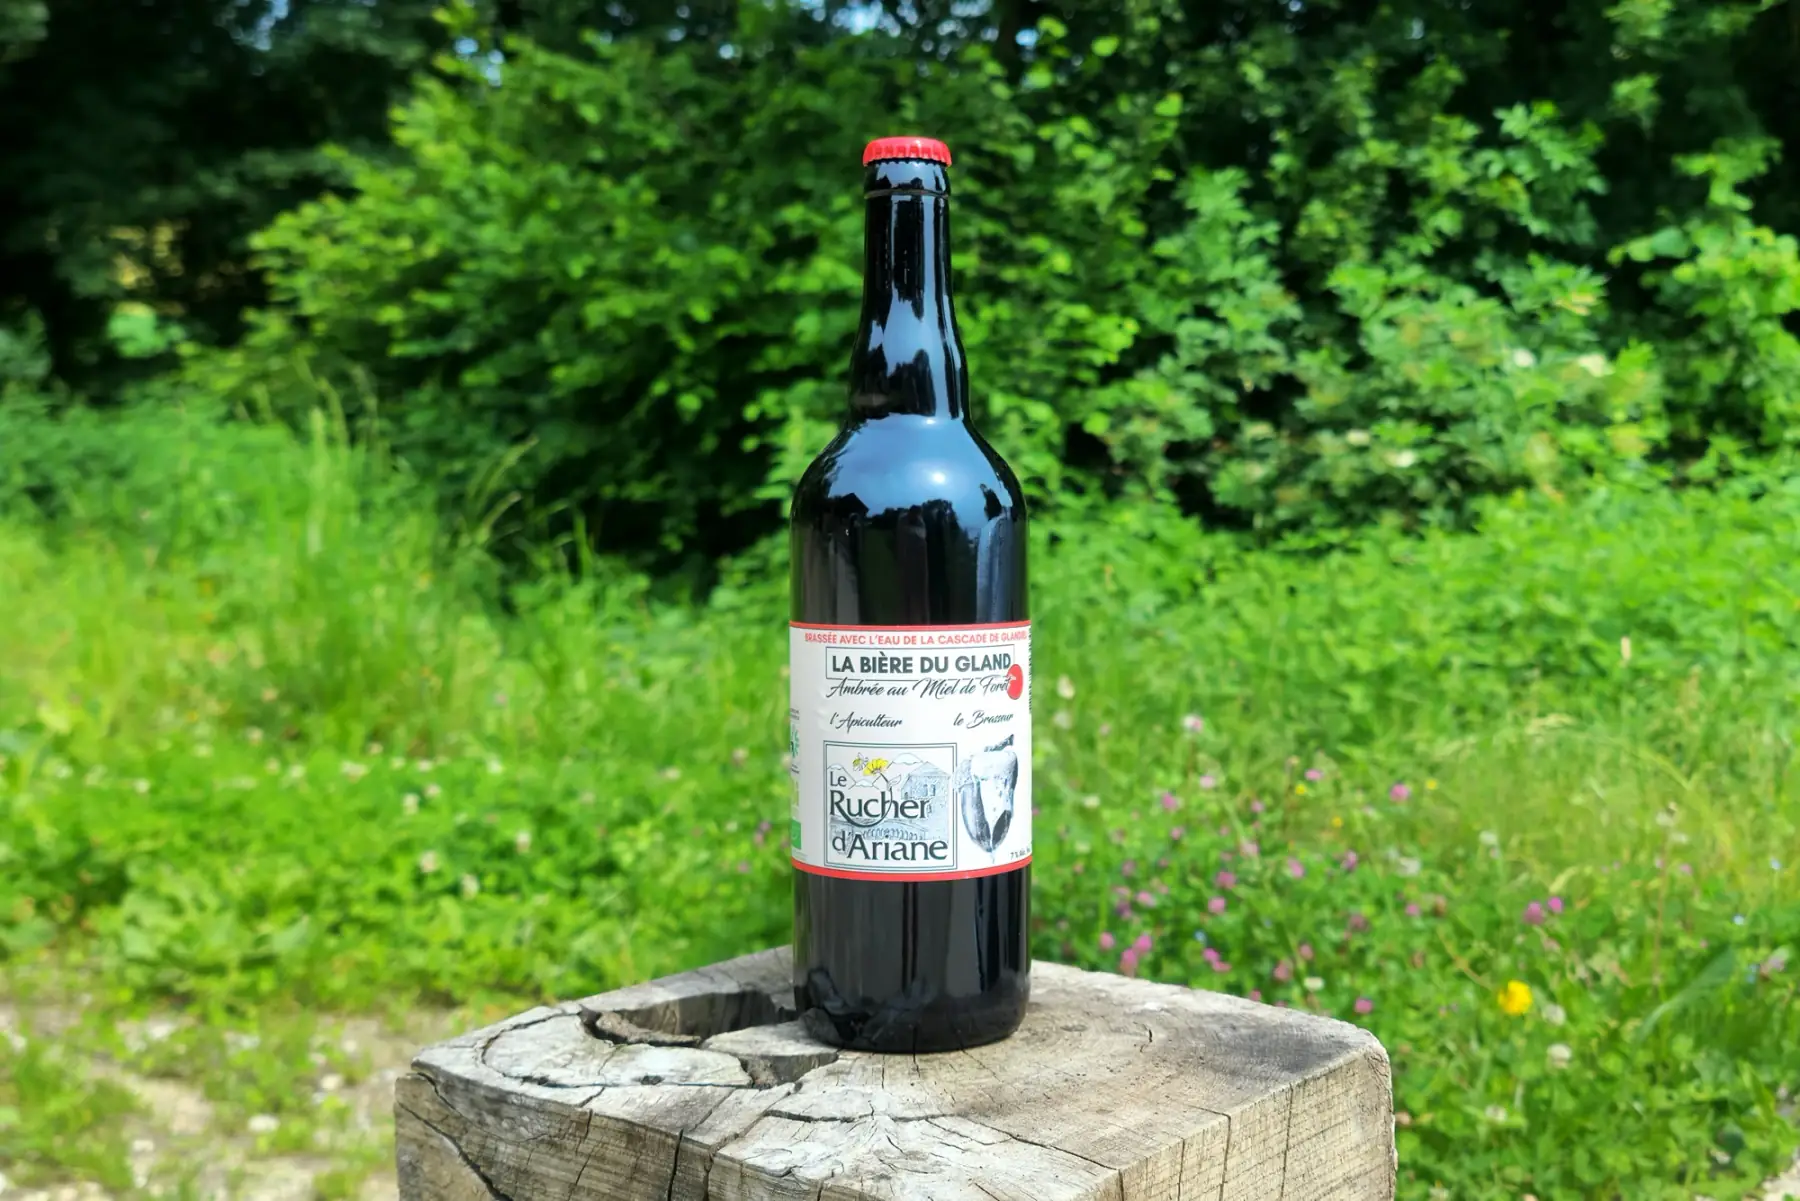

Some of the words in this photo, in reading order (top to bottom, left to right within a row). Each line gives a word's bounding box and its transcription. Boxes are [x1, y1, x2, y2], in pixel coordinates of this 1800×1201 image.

[805, 632, 837, 644] BRASSÉE
[839, 633, 866, 644] AVEC
[869, 633, 901, 645] L'EAU
[903, 633, 917, 645] DE
[920, 633, 935, 645] LA
[938, 633, 987, 645] CASCADE
[989, 632, 998, 642] DE
[832, 655, 855, 673] LA
[860, 651, 913, 674] BIÈRE
[920, 655, 949, 674] DU
[955, 652, 1012, 672] GLAND
[826, 677, 885, 699] Ambrée
[887, 684, 908, 696] au
[912, 677, 956, 699] Miel
[958, 678, 976, 694] de
[978, 675, 1012, 694] Forêt
[829, 711, 903, 733] l'Apiculteur
[953, 712, 964, 727] le
[966, 709, 1014, 729] Brasseur
[830, 771, 847, 787] Le
[829, 789, 930, 828] Rucher
[832, 831, 948, 861] d'Ariane
